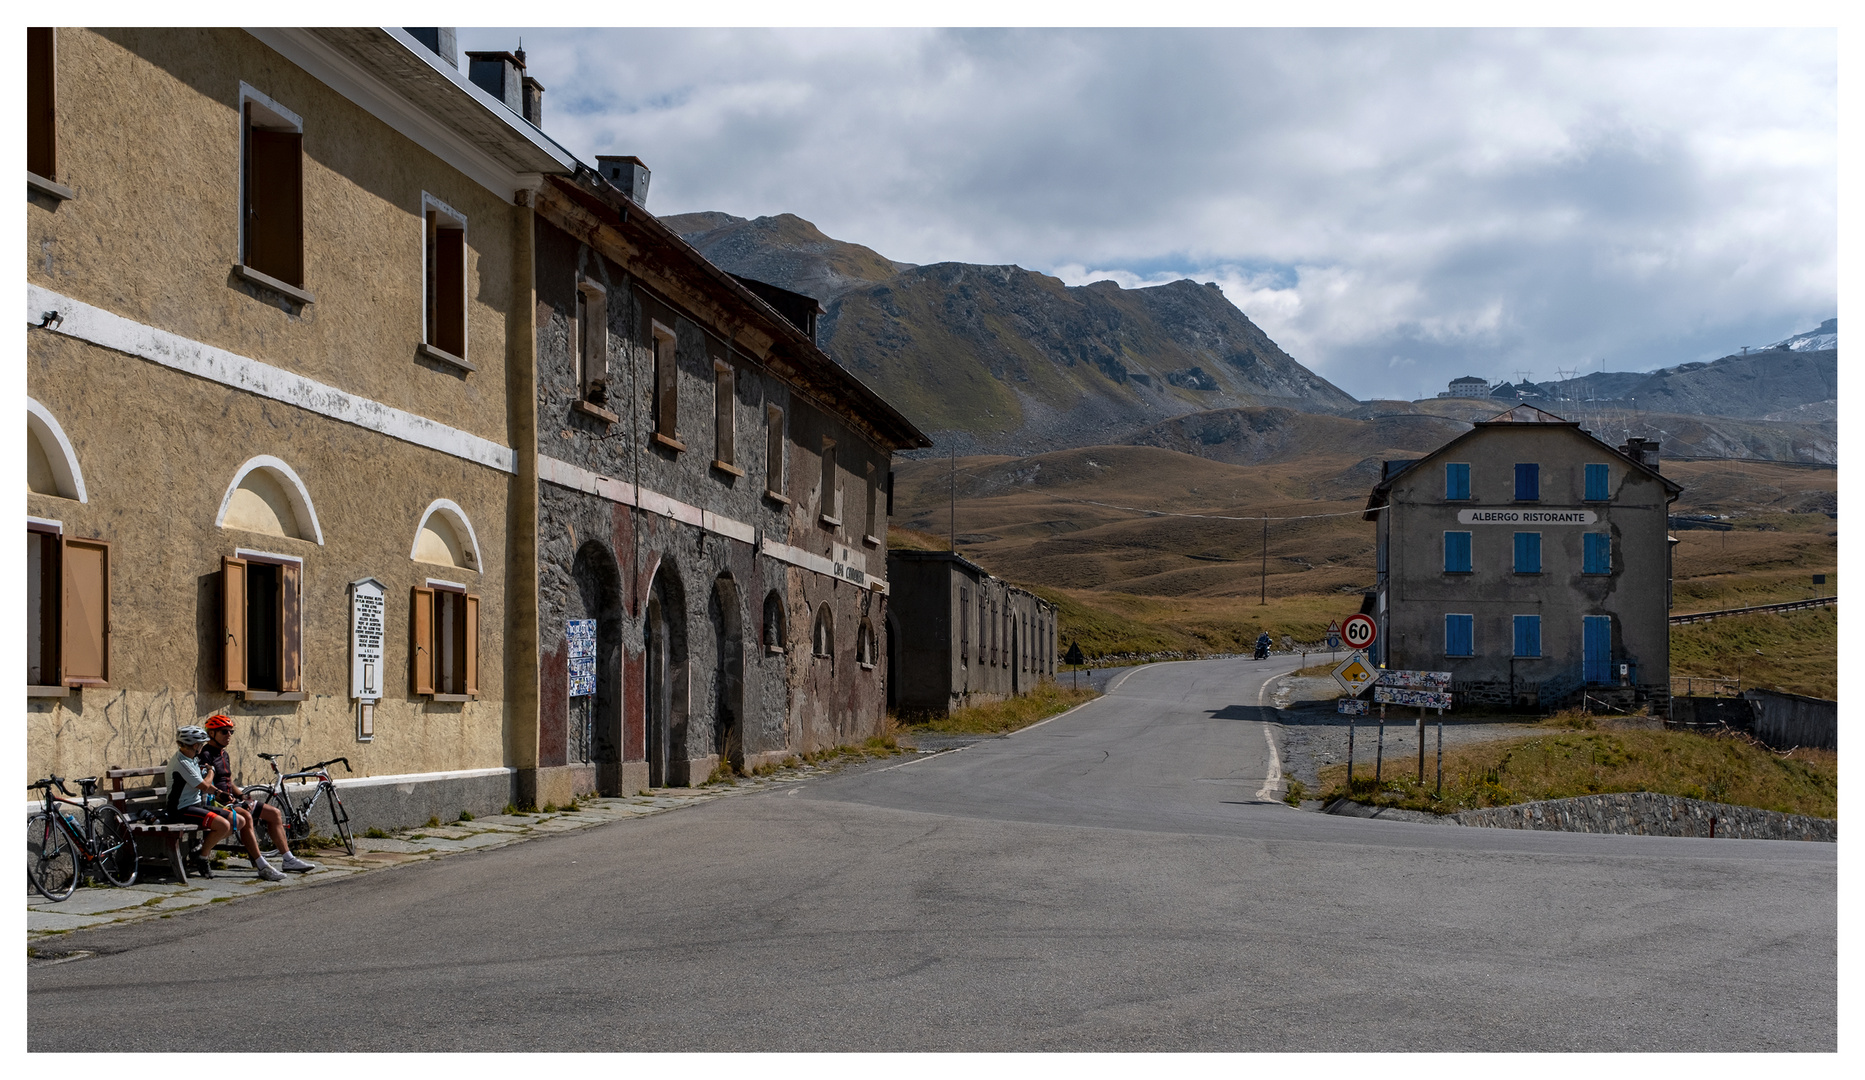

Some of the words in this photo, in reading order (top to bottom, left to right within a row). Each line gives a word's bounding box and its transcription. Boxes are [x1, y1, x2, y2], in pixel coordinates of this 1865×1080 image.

[1471, 512, 1519, 522] ALBERGO
[1523, 512, 1585, 522] RISTORANTE
[1349, 623, 1369, 640] 60
